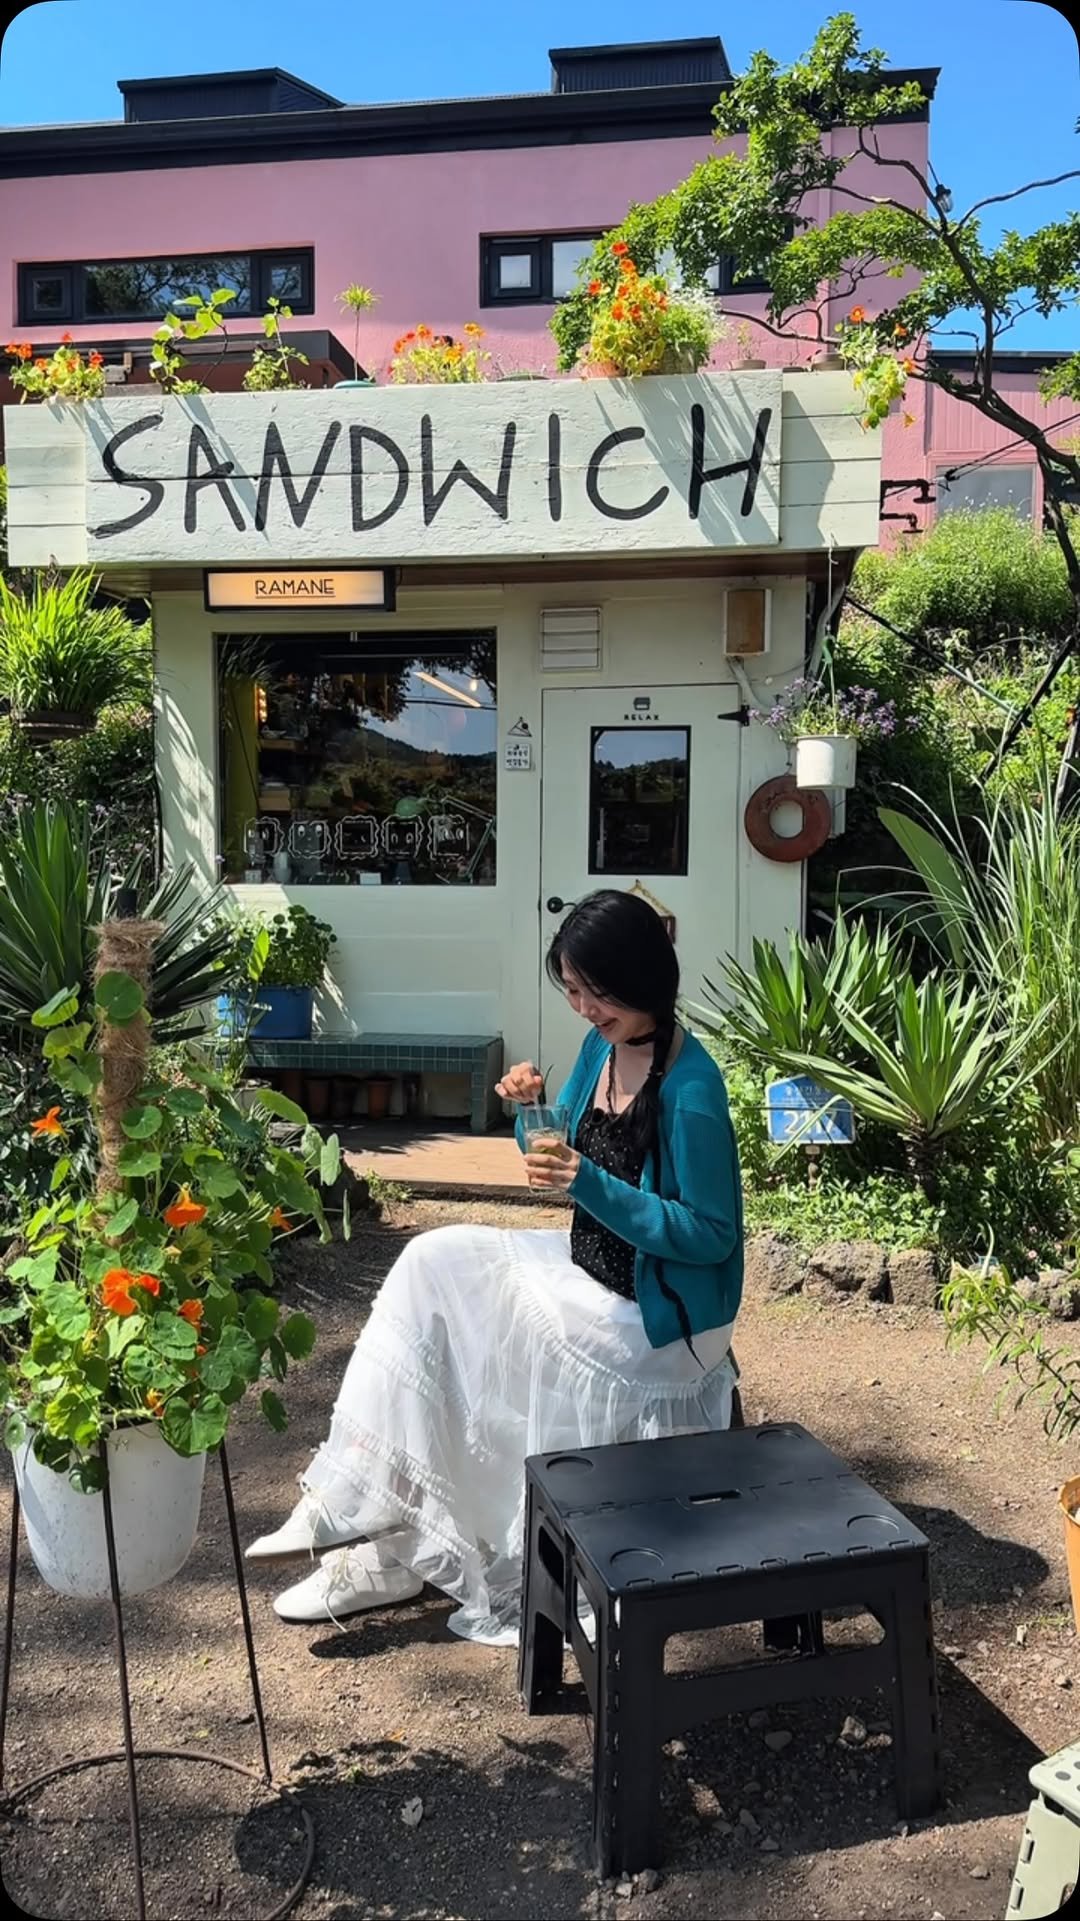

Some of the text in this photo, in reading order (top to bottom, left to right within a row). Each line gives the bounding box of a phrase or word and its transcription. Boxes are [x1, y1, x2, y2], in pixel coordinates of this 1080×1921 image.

[87, 403, 773, 539] SANDWICH
[255, 578, 335, 595] RAMANE
[623, 713, 660, 721] RELAX
